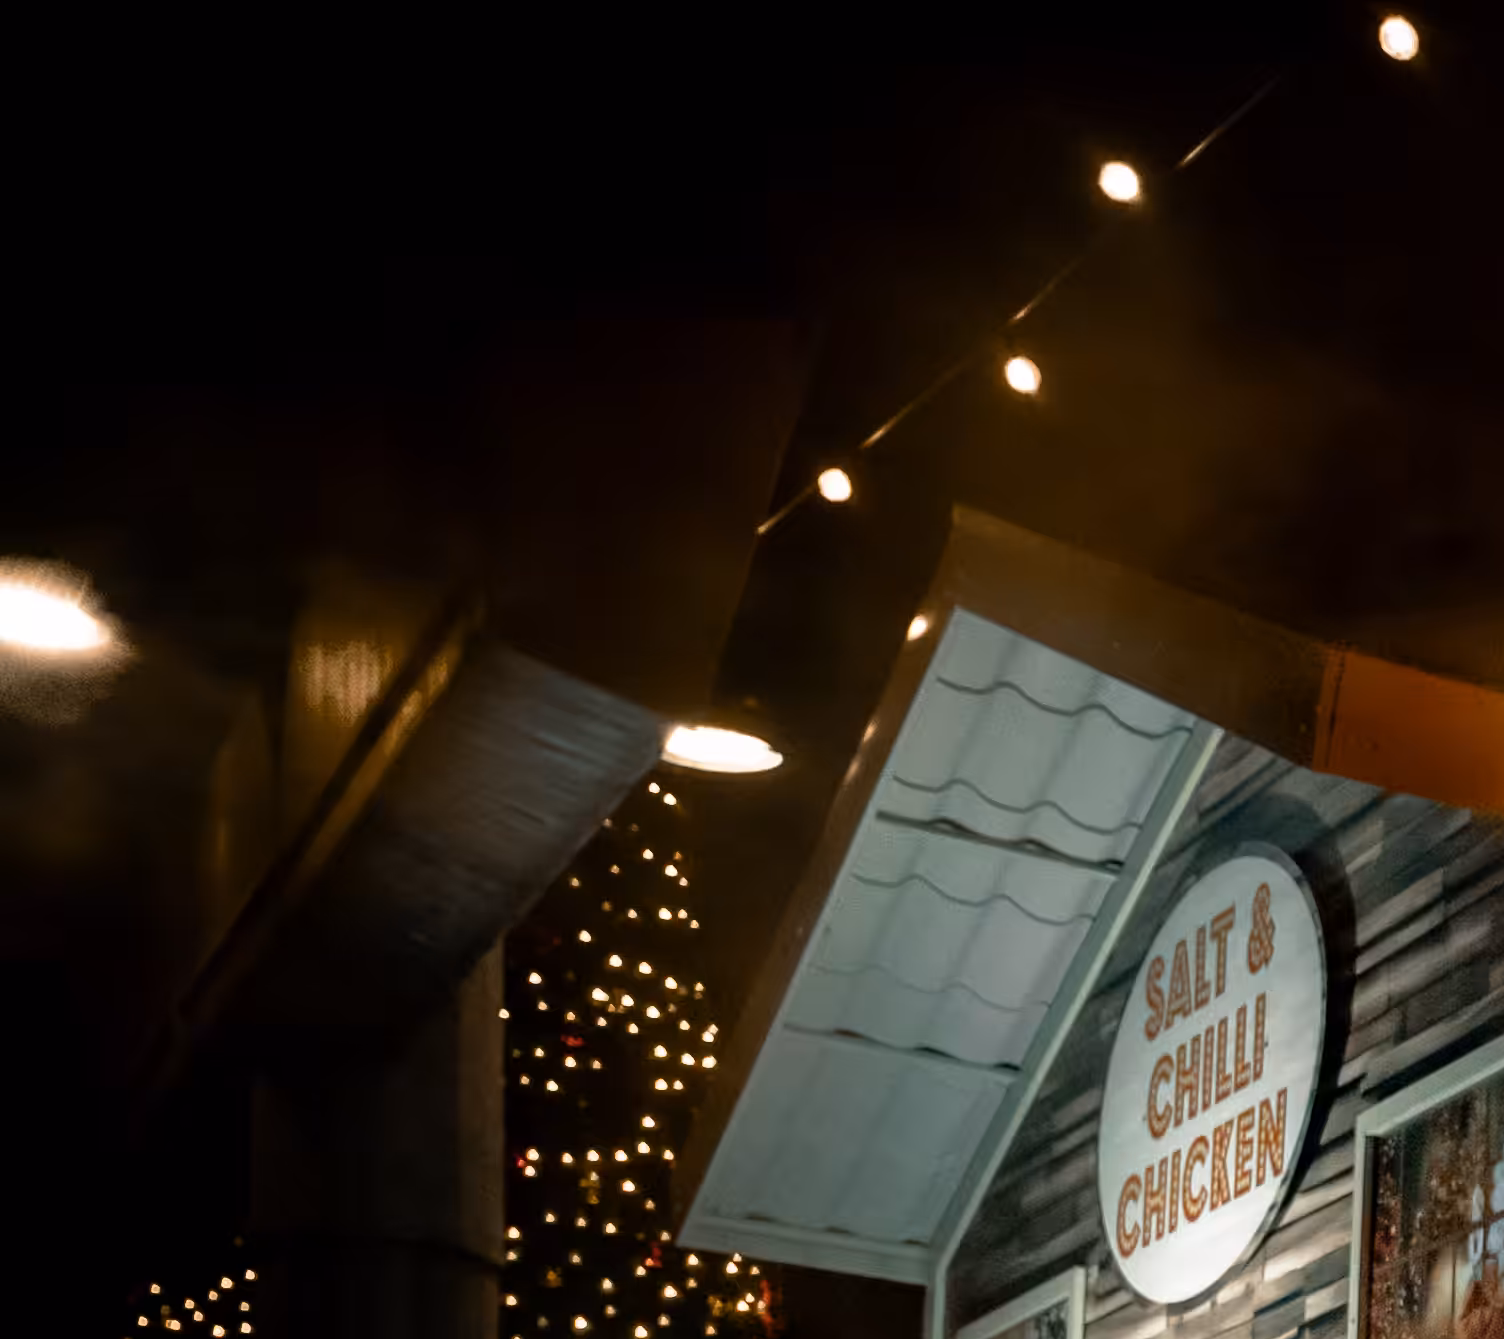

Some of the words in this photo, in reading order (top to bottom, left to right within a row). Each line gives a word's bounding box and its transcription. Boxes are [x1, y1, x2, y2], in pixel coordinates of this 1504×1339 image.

[1144, 905, 1237, 1042] SALT
[1247, 882, 1276, 975] &
[1147, 992, 1267, 1140] CHILLI
[1116, 1087, 1288, 1258] CHICKEN
